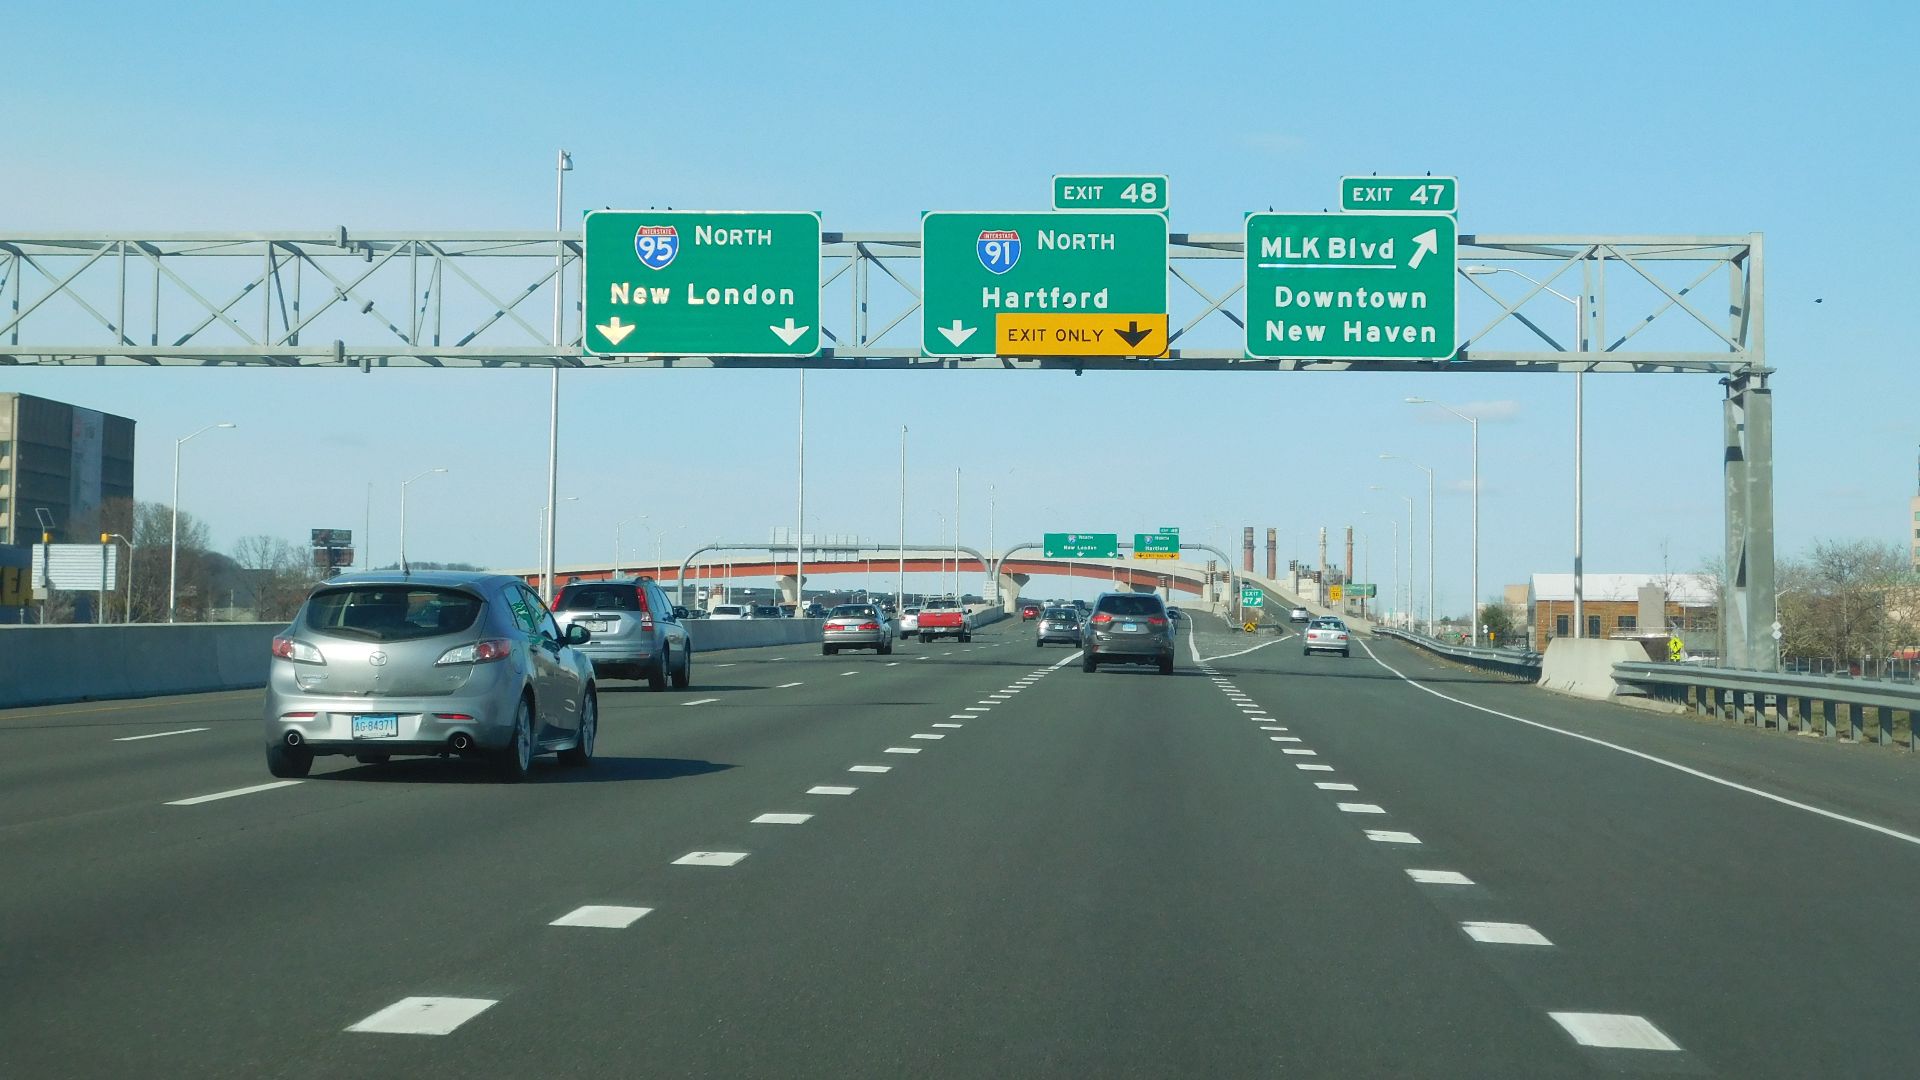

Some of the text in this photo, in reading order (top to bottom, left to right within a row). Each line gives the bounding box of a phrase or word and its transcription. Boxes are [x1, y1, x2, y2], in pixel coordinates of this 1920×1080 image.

[1064, 183, 1157, 203] EXIT 48
[1353, 184, 1445, 205] EXIT 47
[642, 228, 672, 236] INTERSTATE
[695, 225, 772, 246] NORTH
[1037, 230, 1116, 250] NORTH
[638, 237, 674, 261] 95
[985, 241, 1010, 265] 91
[1261, 236, 1394, 259] MLK Blvd
[610, 282, 795, 306] New London
[982, 286, 1109, 309] Hartford
[1275, 285, 1428, 309] Downtown
[1008, 328, 1104, 342] EXIT ONLY
[1266, 320, 1437, 343] New Haven
